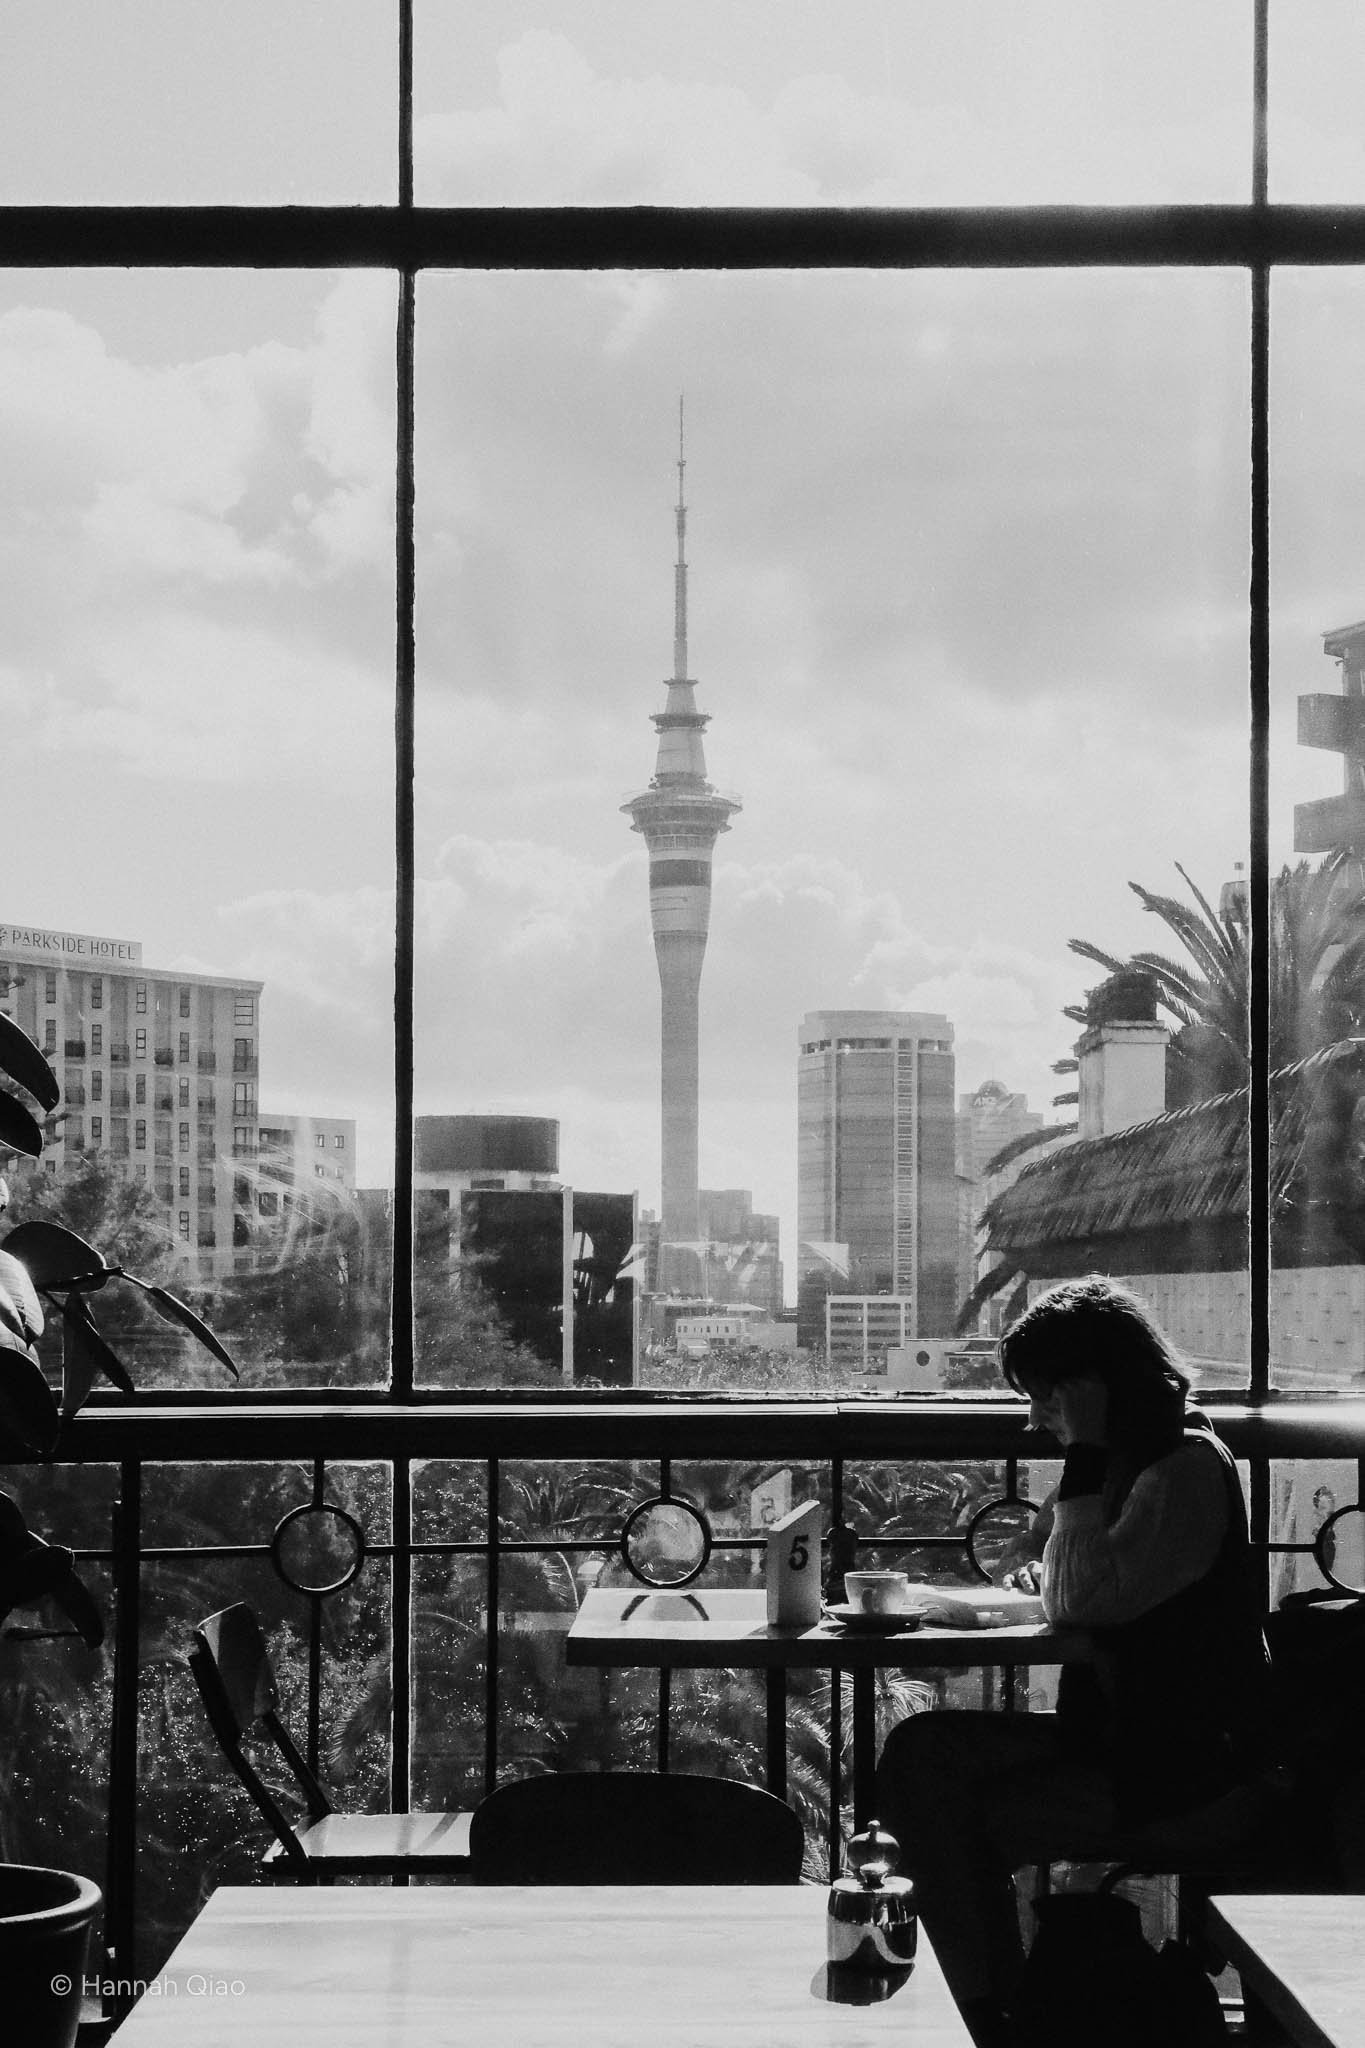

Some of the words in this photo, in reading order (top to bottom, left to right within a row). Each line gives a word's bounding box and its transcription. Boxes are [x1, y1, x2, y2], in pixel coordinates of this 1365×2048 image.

[12, 930, 86, 953] PARKSIDE
[91, 941, 136, 960] HOTEL
[789, 1535, 809, 1571] 5
